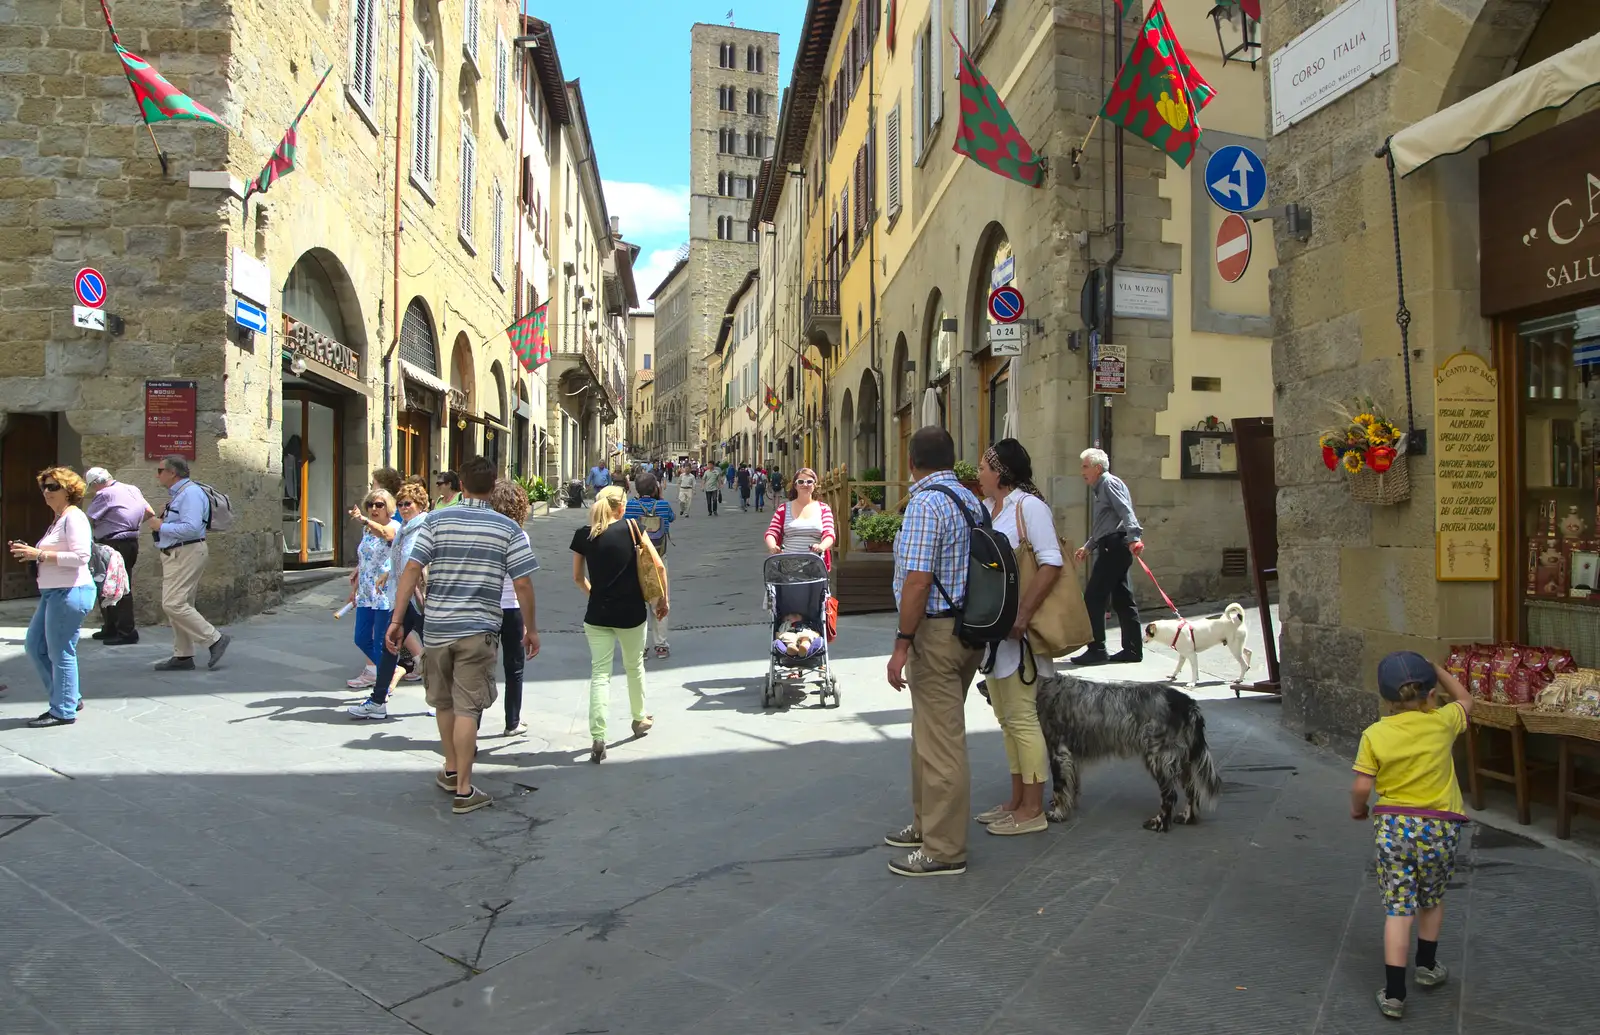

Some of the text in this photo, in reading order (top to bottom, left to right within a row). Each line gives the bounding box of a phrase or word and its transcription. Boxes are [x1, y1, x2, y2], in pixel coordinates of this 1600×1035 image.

[1292, 31, 1366, 87] CORSO ITALIA
[1300, 64, 1362, 106] ANTICO BORGO MAESTRO
[1119, 283, 1164, 294] VIA MAZZINI
[1005, 328, 1014, 336] 24
[1436, 375, 1444, 386] AL
[1445, 365, 1467, 378] CANTO
[1480, 370, 1497, 388] BACCI
[1449, 419, 1486, 429] ALIMENTARI
[1439, 432, 1495, 442] SPECIALITY FOODS
[1445, 443, 1491, 452] OF TUSCANY
[1451, 481, 1484, 489] VINSANTO
[1440, 496, 1454, 505] OLIO
[1440, 506, 1494, 515] DEI COLLI ARETINI
[1440, 522, 1496, 532] ENOTECA TOSCANA
